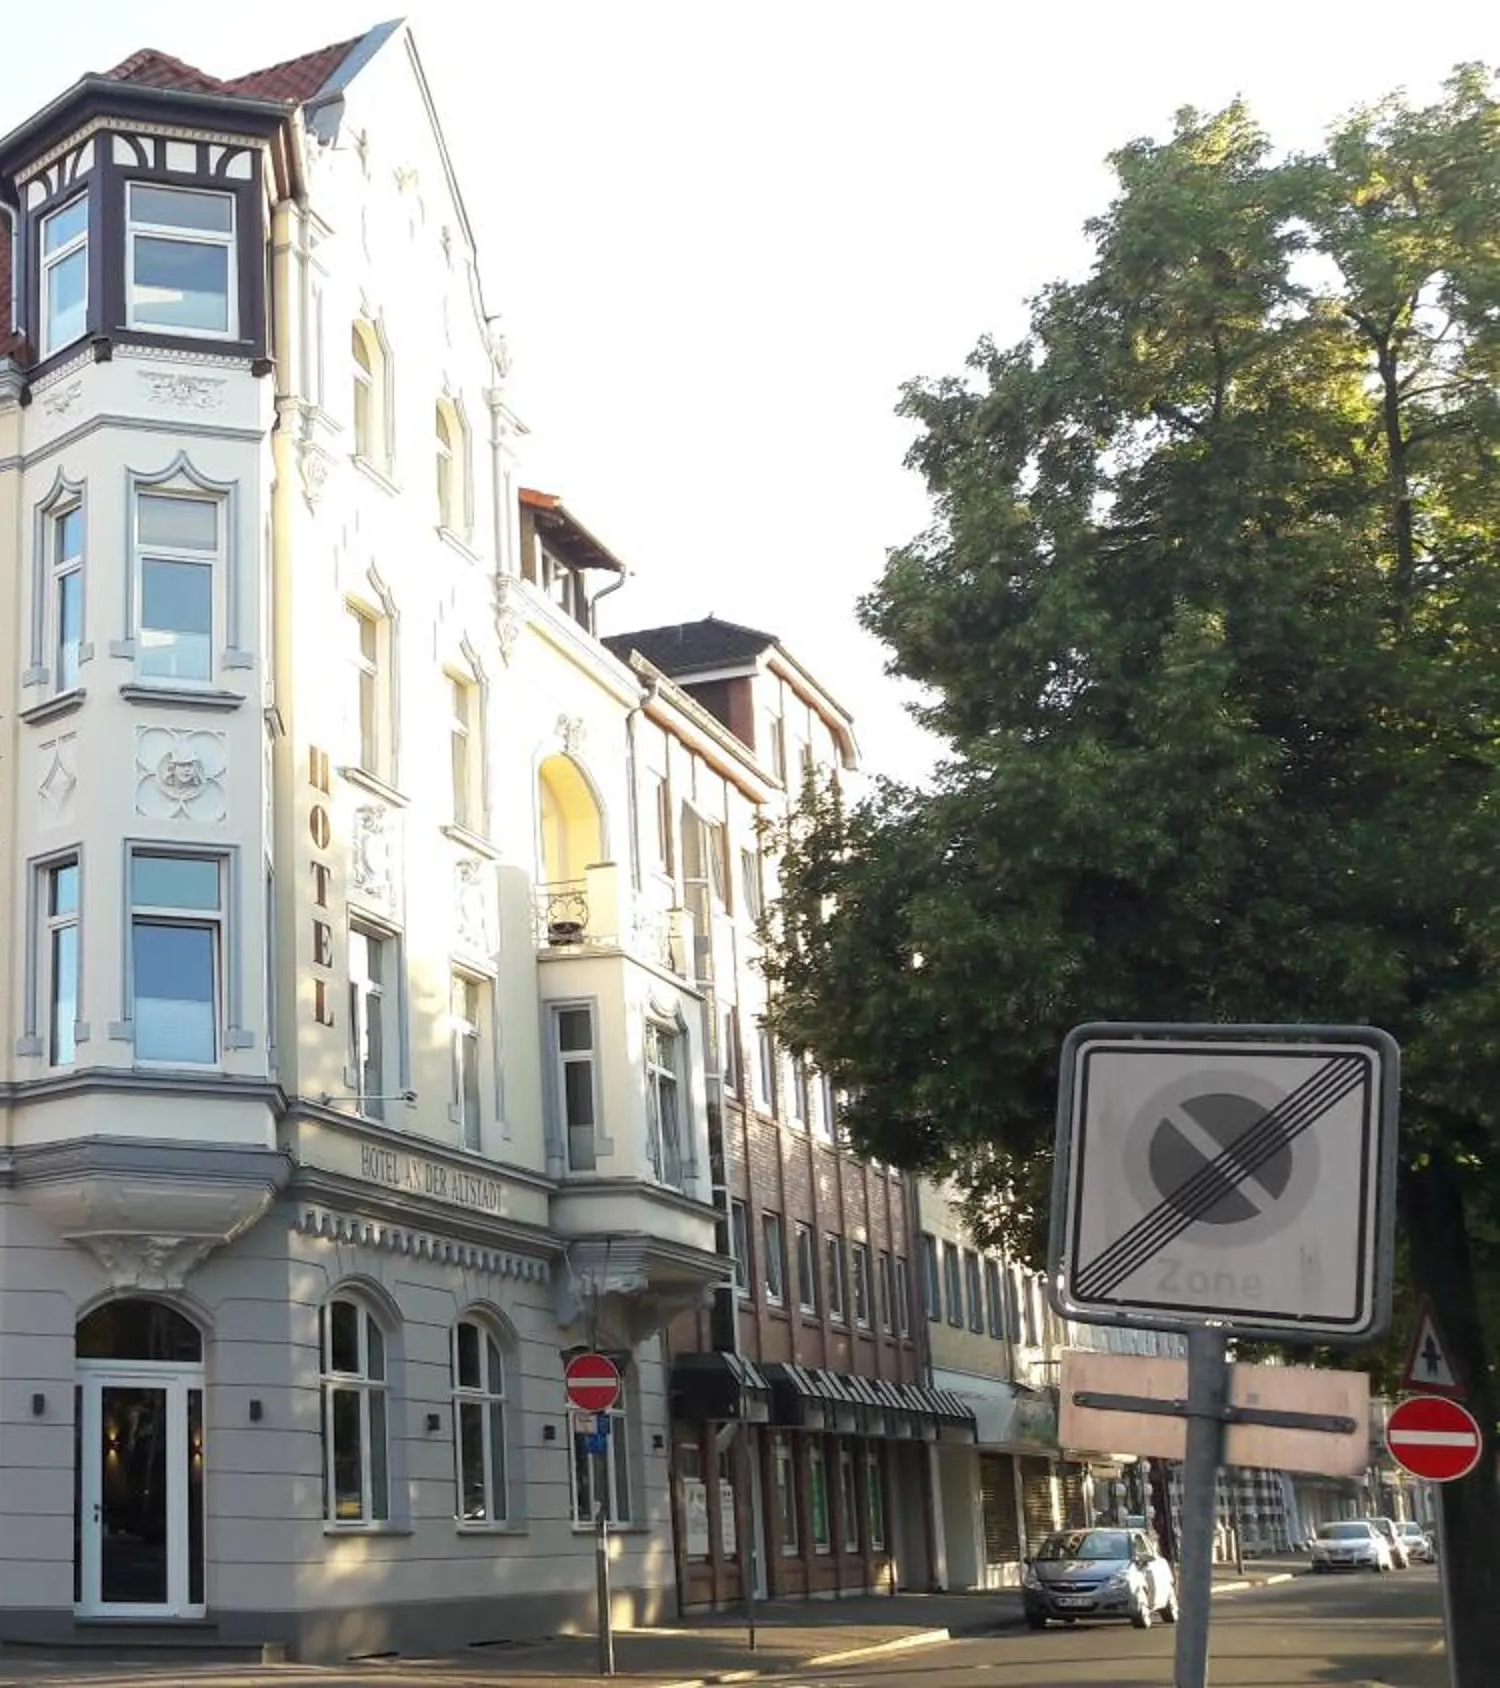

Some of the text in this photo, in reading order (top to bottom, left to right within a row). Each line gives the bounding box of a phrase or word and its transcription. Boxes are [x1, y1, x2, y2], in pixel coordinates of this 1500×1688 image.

[307, 745, 334, 1028] HOTEL
[361, 1144, 399, 1185] HOTEL
[425, 1163, 447, 1197] DER
[451, 1171, 501, 1214] ALTSTADT
[1156, 1257, 1263, 1299] Zone
